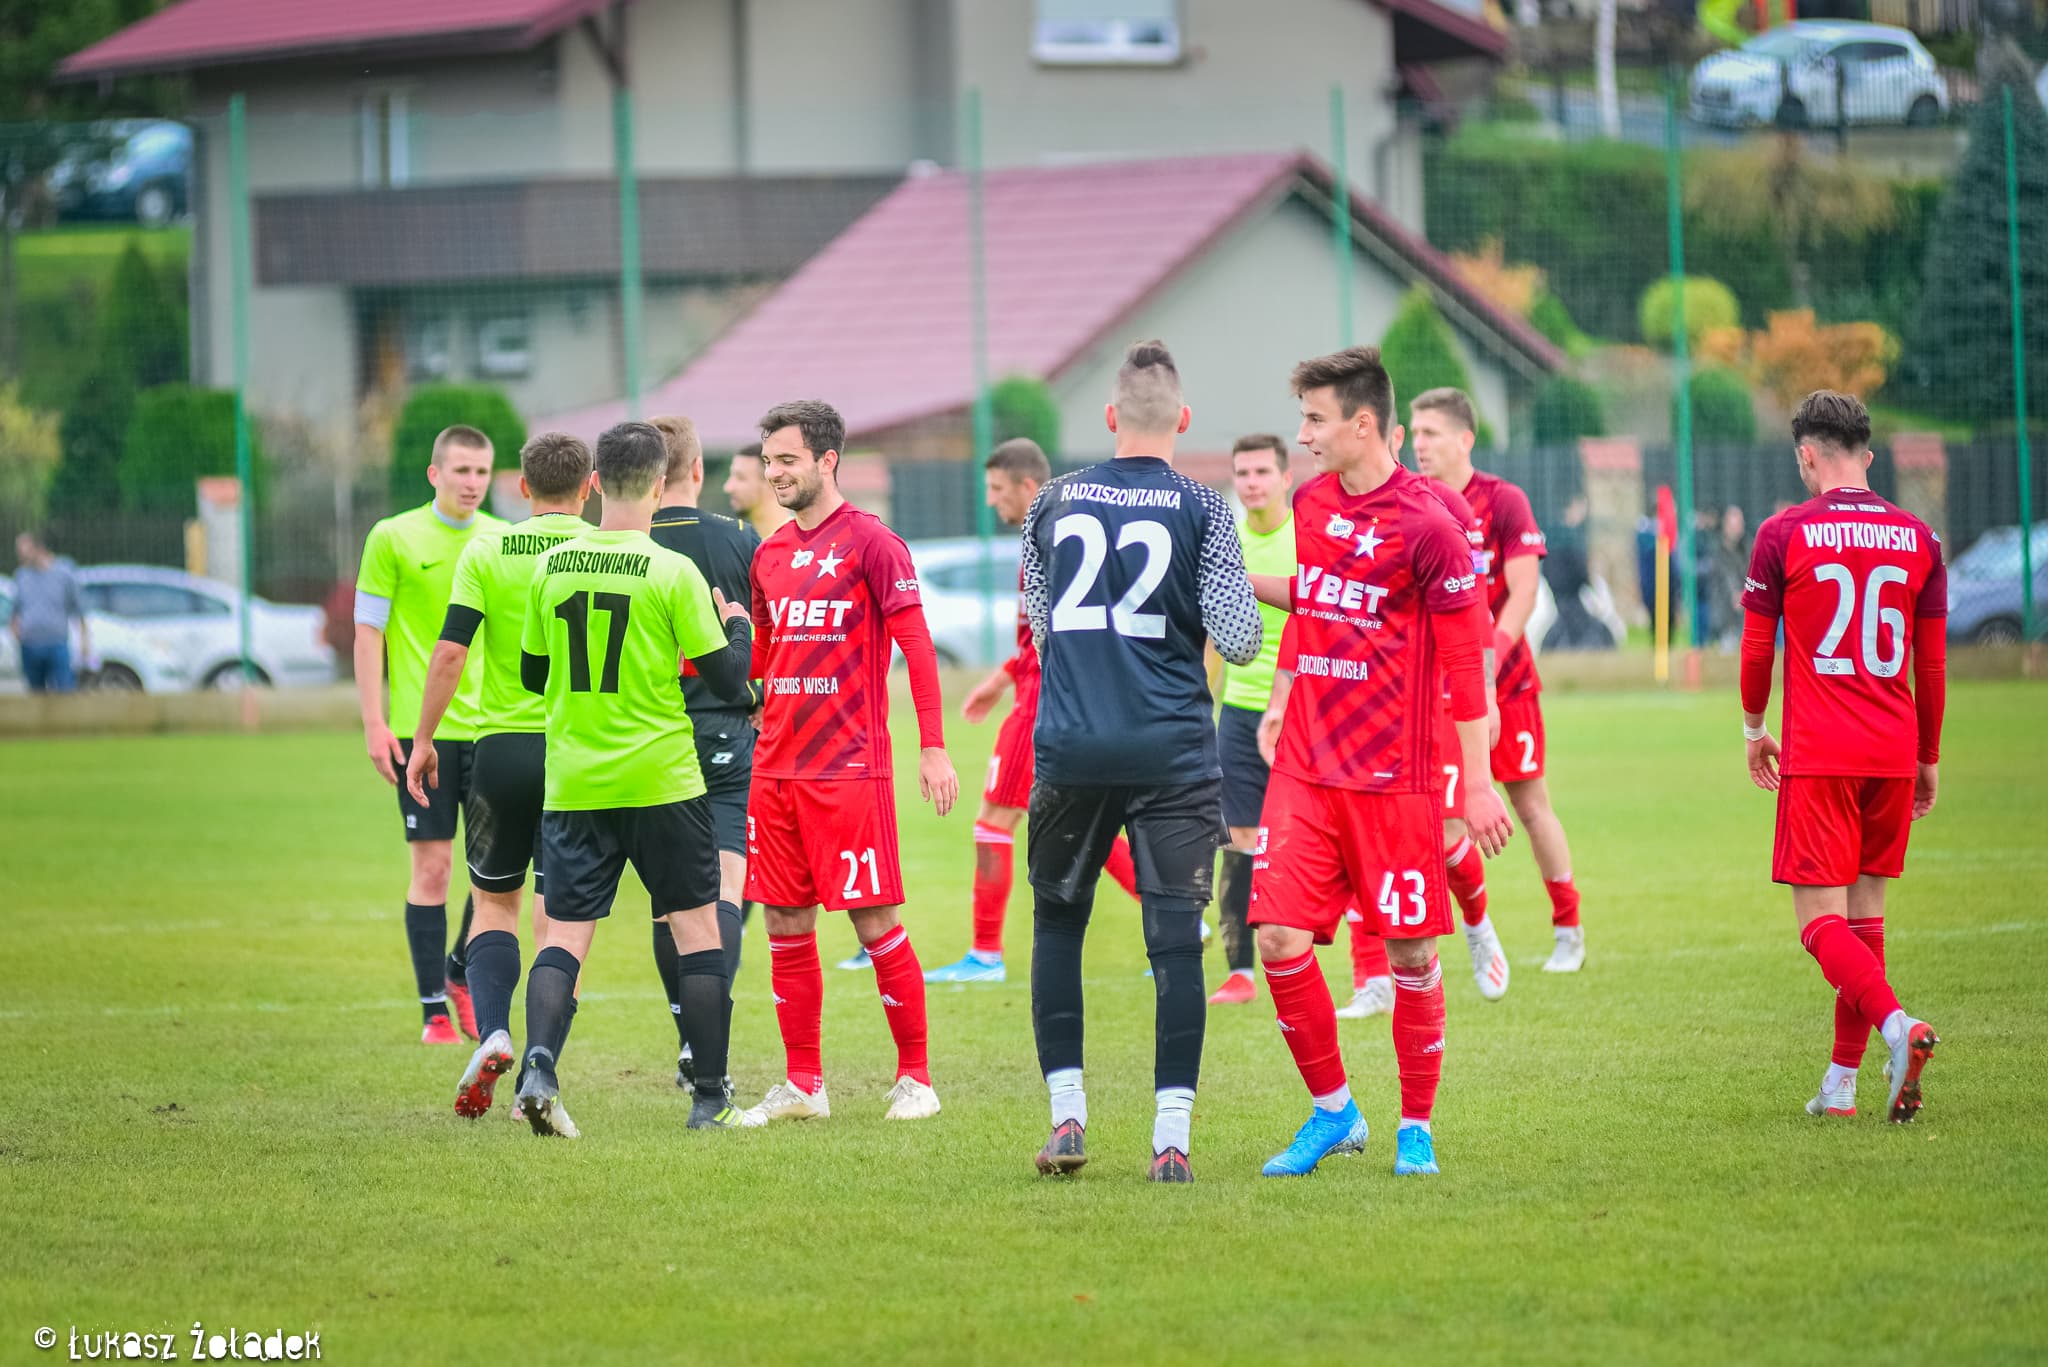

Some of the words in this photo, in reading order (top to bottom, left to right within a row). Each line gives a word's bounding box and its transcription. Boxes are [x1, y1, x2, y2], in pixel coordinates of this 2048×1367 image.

[1061, 482, 1182, 510] RADZISZOWIANKA
[1802, 522, 1918, 554] WOJTKOWSKI
[546, 550, 651, 578] RADZISZOWIANKA
[1051, 513, 1173, 640] 22
[1311, 609, 1384, 630] BUKMACHERSKIE
[1812, 563, 1909, 679] 26
[554, 590, 632, 694] 17
[773, 677, 801, 695] SOCIOS
[803, 676, 839, 695] WISŁA
[1330, 658, 1369, 681] WISŁA
[1516, 731, 1538, 773] 2
[839, 847, 881, 900] 21
[1378, 869, 1428, 927] 43
